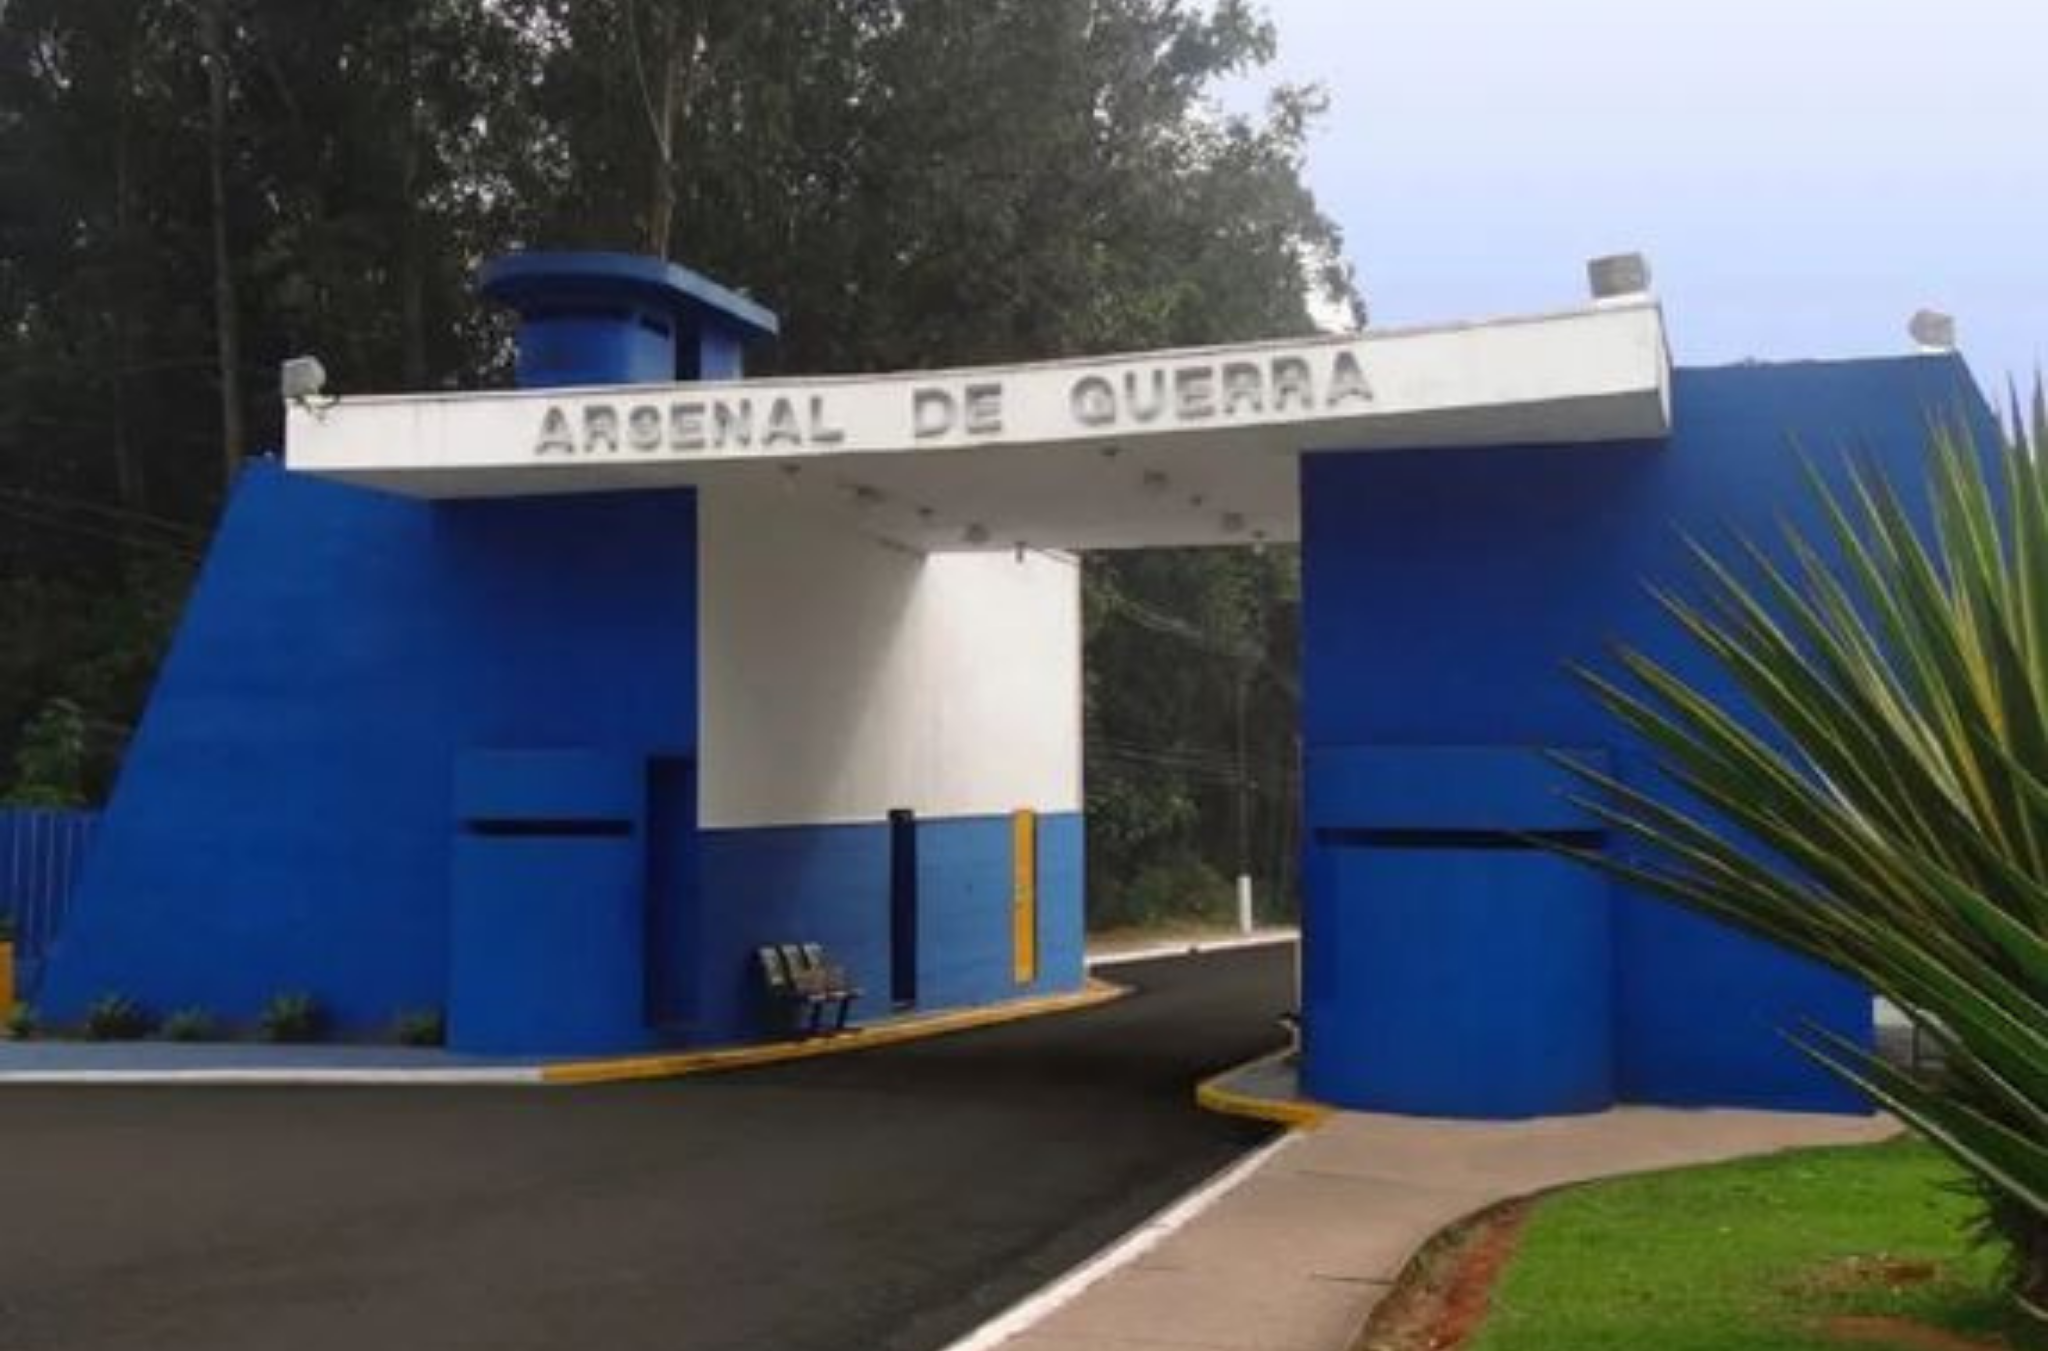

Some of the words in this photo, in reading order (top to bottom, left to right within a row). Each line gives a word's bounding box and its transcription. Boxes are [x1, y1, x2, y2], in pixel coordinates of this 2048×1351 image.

[535, 396, 845, 456] ARSENAL
[912, 383, 1002, 438] DE
[1070, 351, 1375, 427] GUERRA
